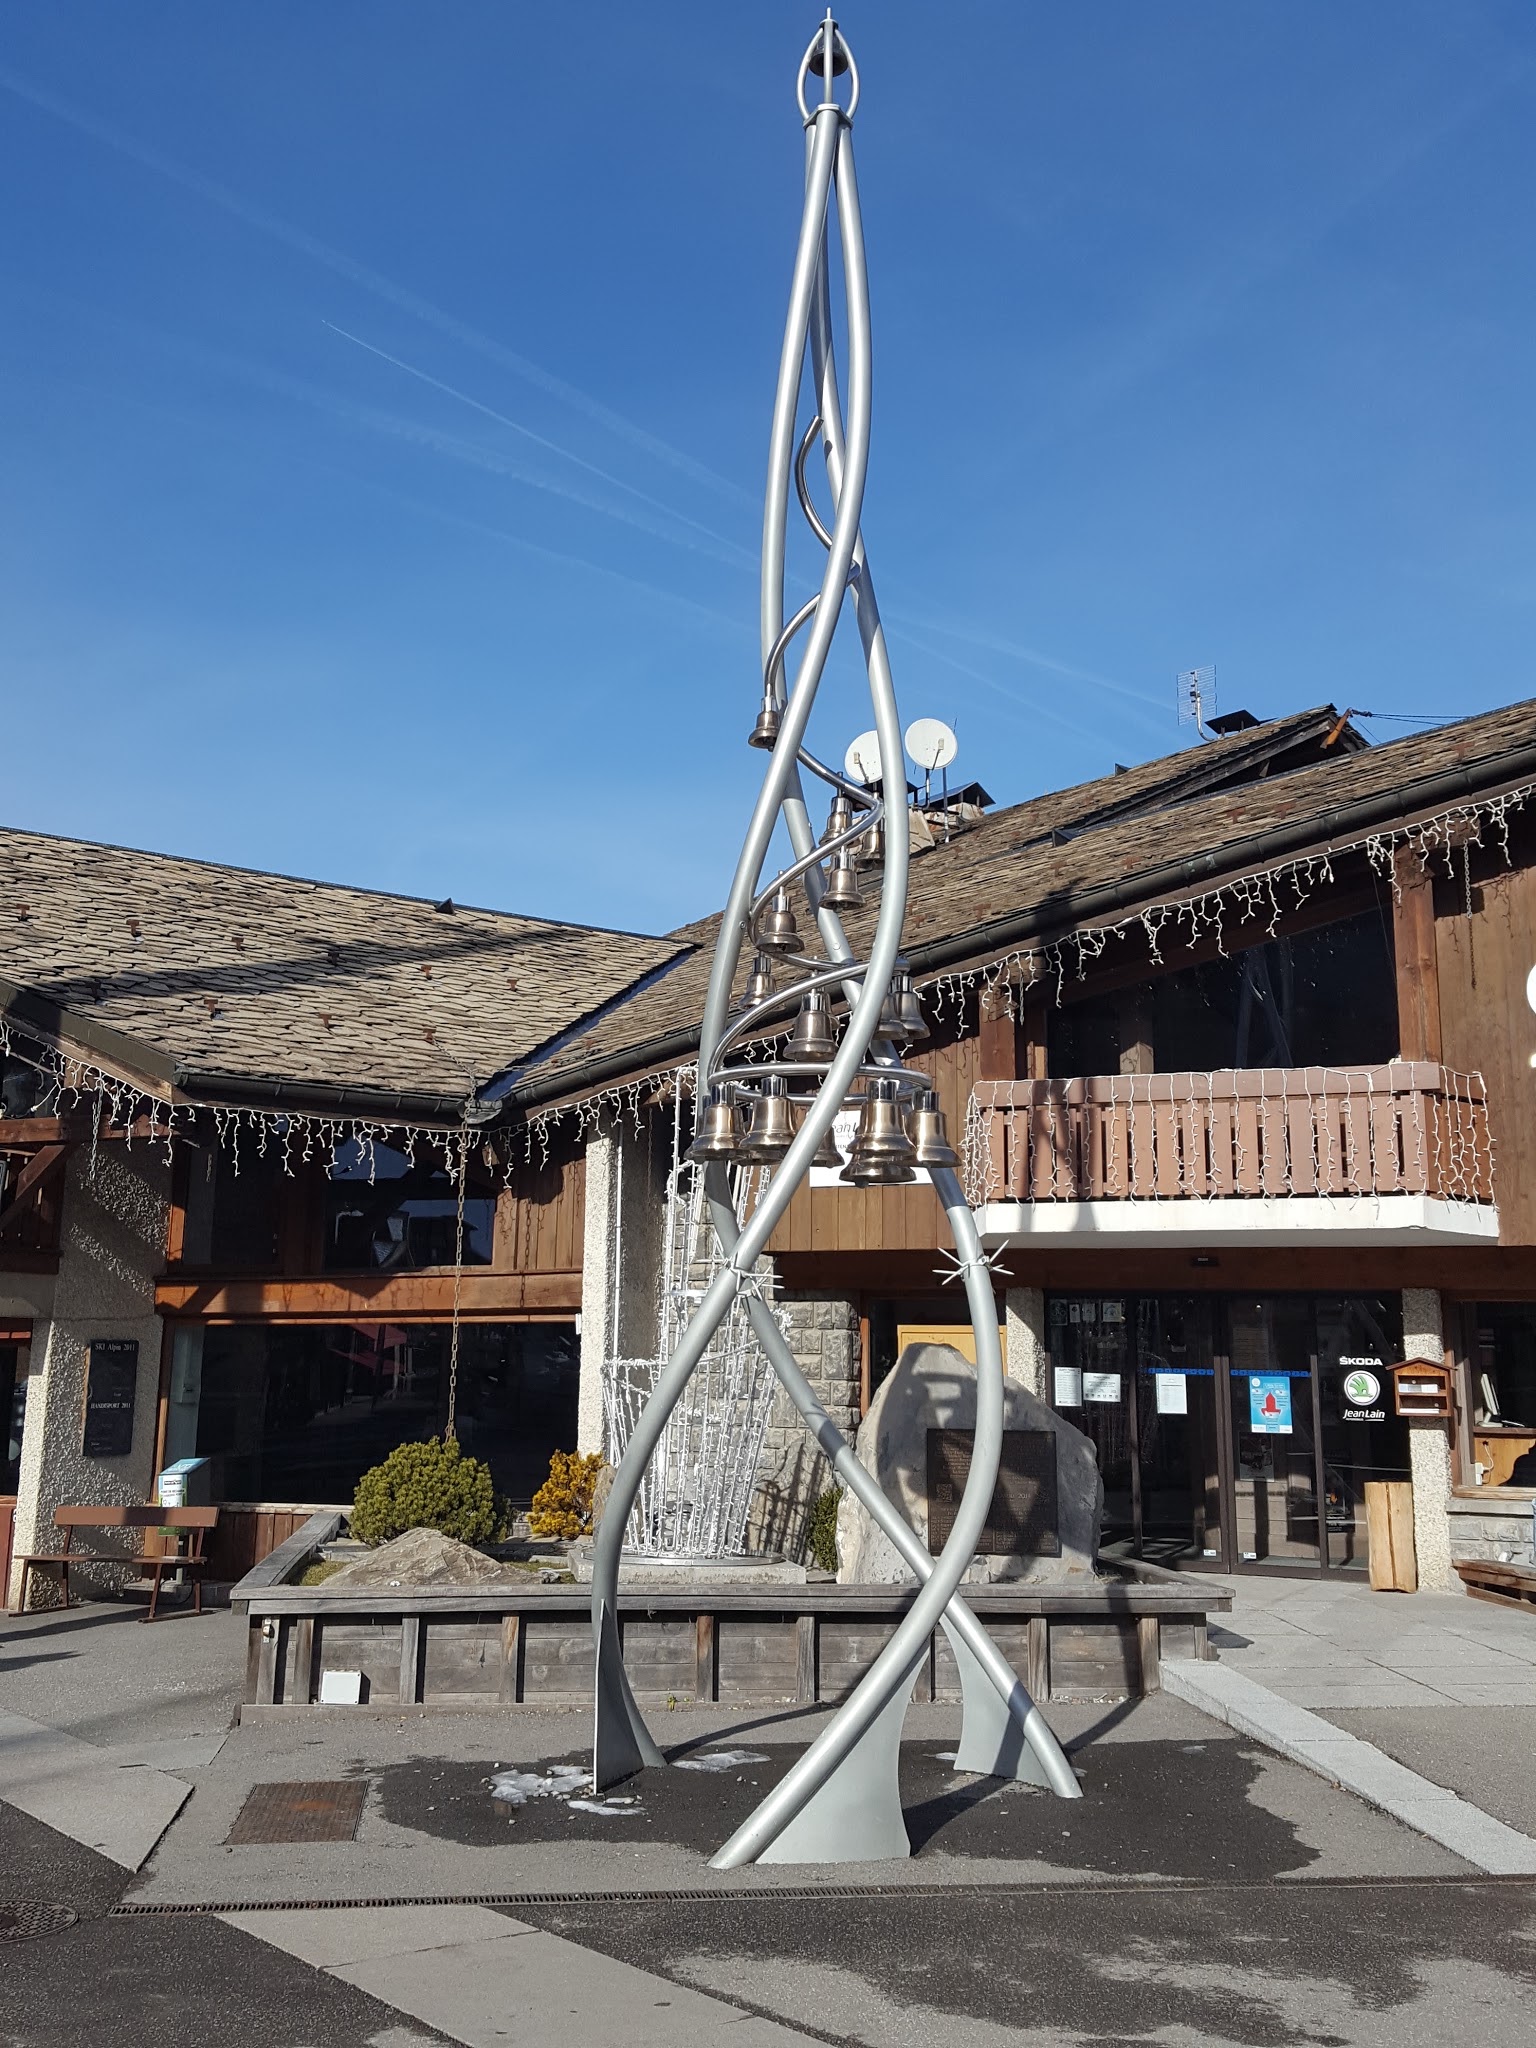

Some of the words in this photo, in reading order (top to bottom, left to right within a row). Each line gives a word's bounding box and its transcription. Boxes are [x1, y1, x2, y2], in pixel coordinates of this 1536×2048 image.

[95, 1343, 105, 1351] SKI
[124, 1343, 135, 1351] 2011
[1339, 1356, 1383, 1366] ŠKODA
[1343, 1409, 1365, 1419] Jean
[1365, 1409, 1385, 1418] Lain
